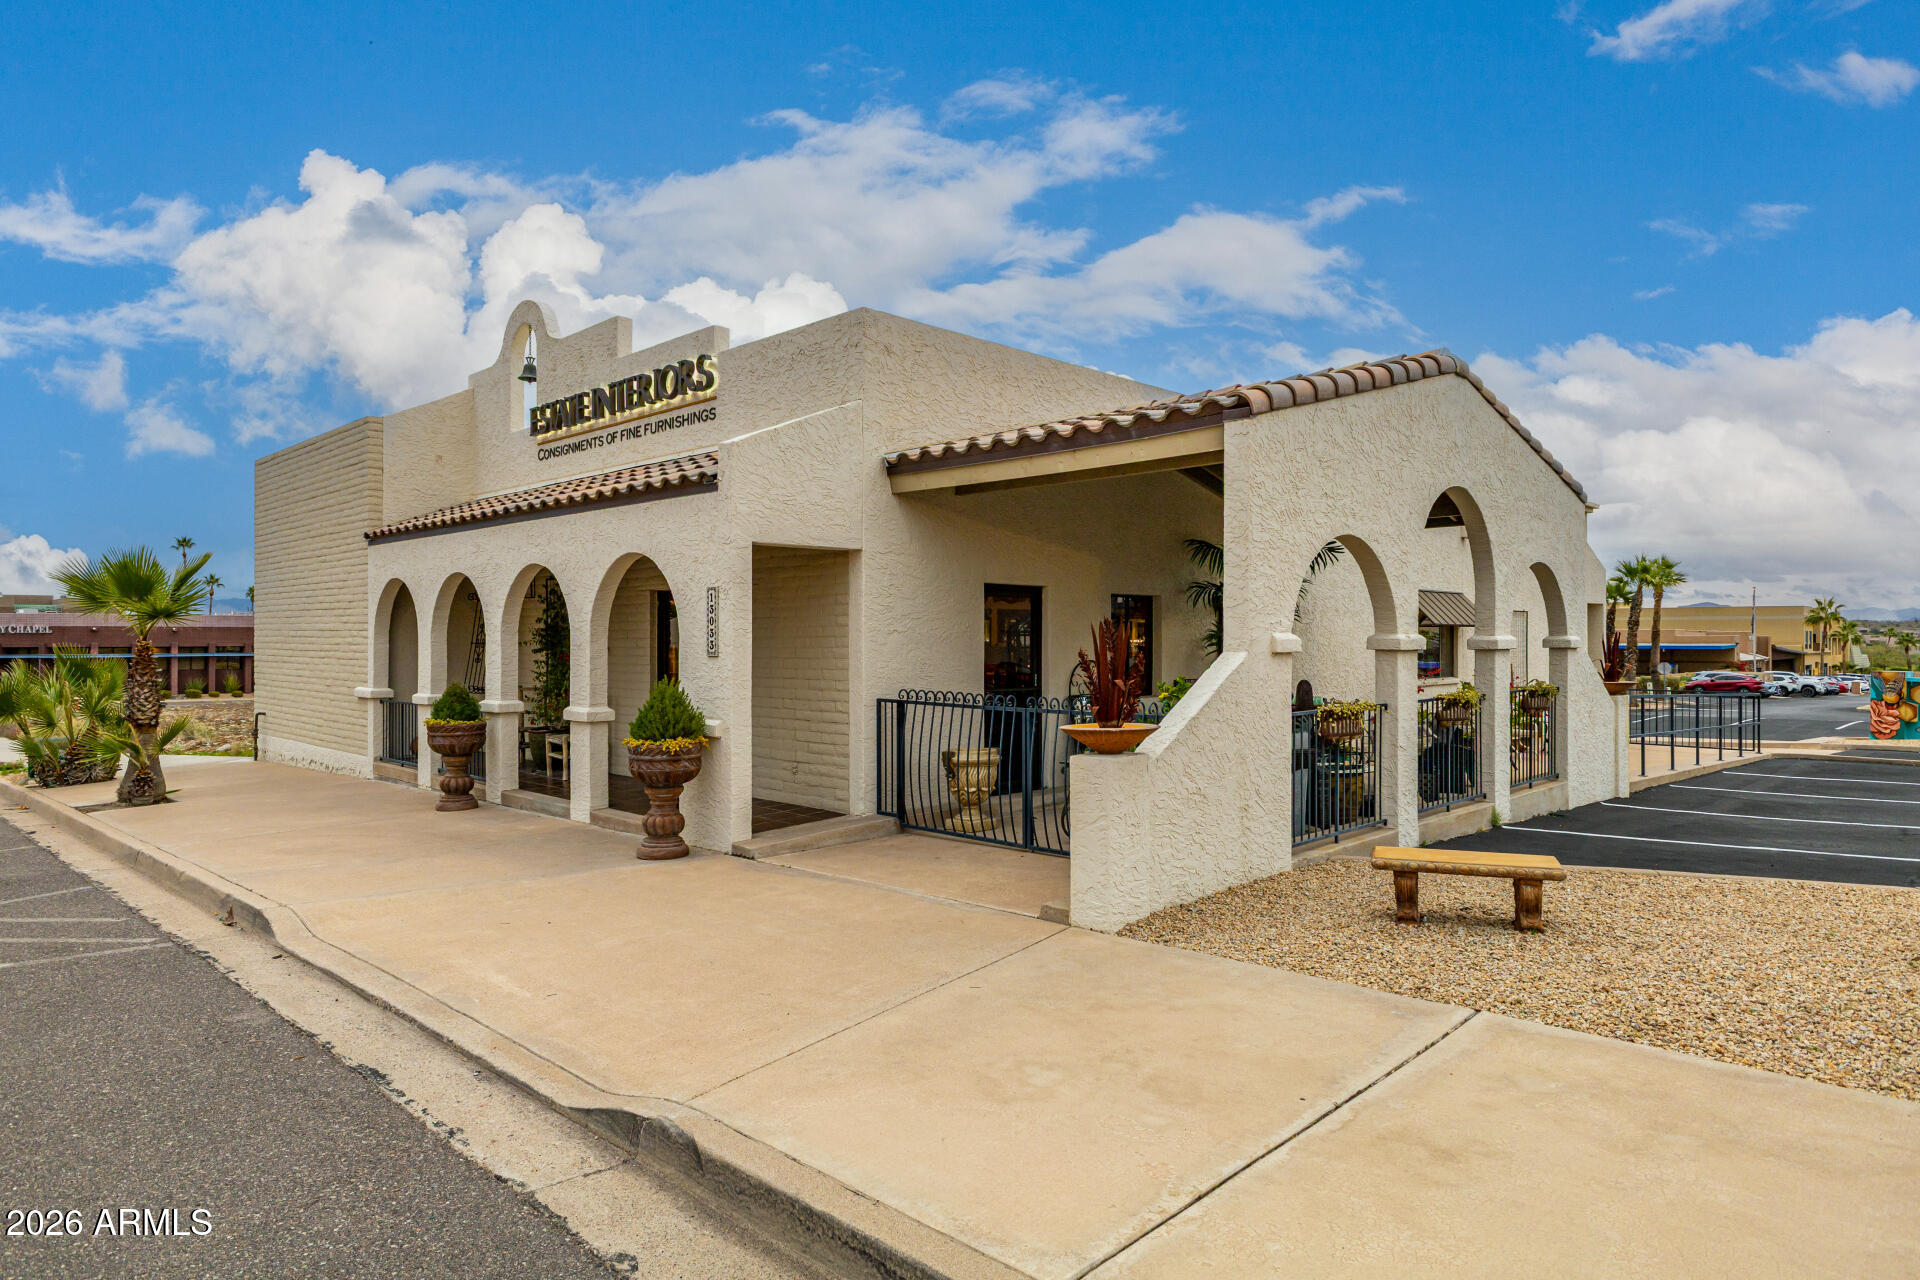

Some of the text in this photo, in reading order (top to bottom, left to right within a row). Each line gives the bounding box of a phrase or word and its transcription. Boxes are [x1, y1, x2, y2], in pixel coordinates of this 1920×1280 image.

[530, 354, 715, 437] ESTATE INTERIORS
[537, 407, 717, 461] CONSIGNMENTS OF FINE FURNISHINGS
[8, 624, 53, 634] CHAPEL
